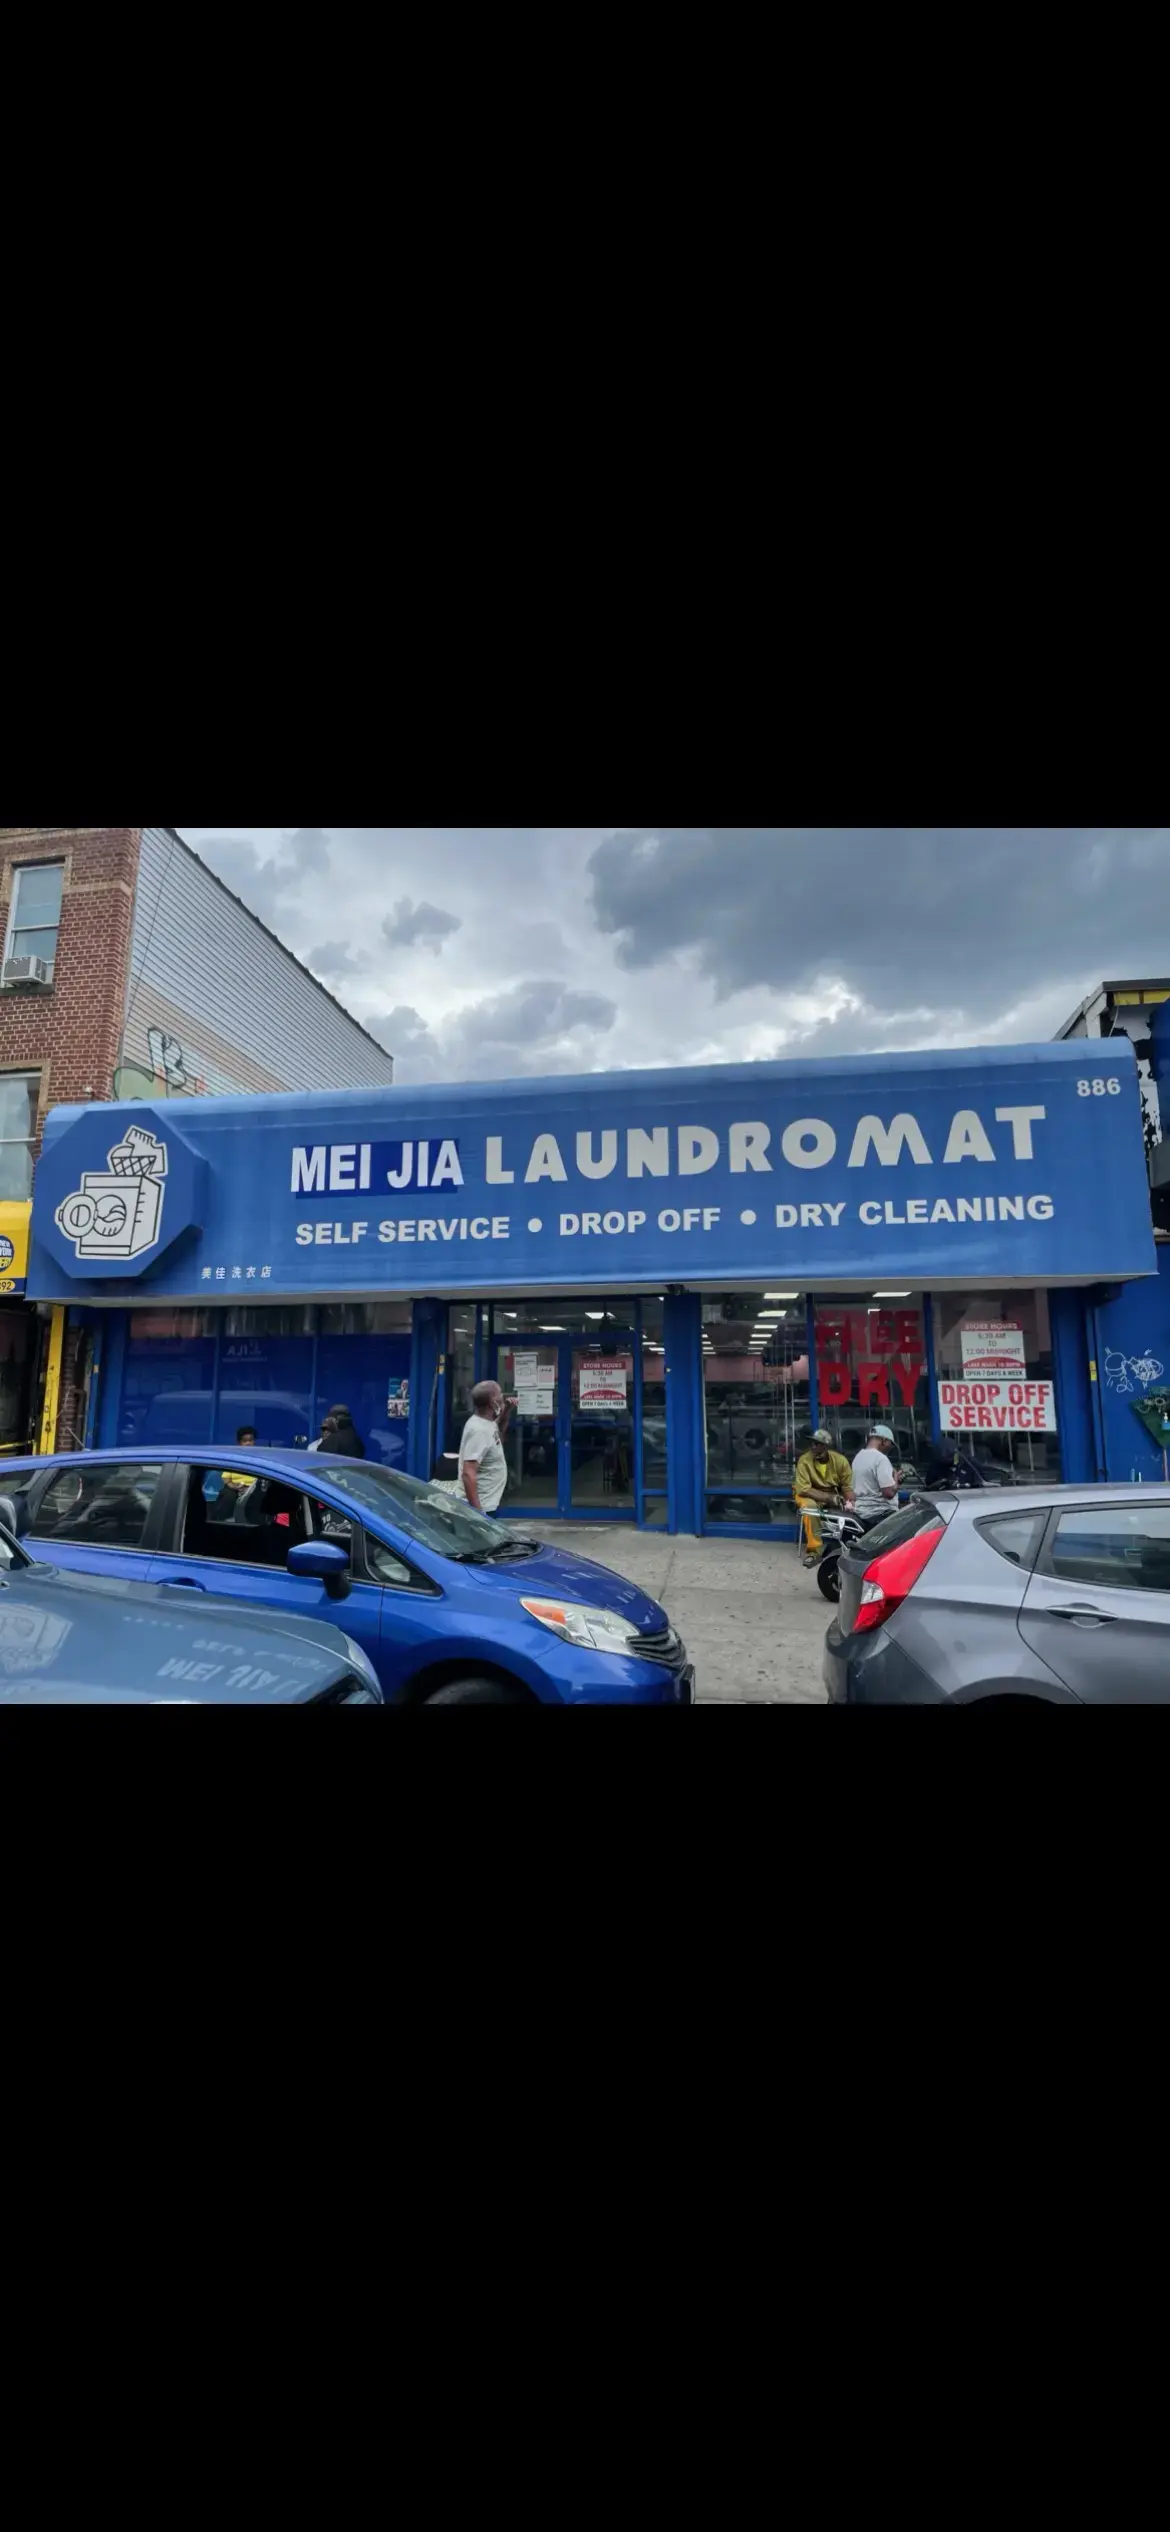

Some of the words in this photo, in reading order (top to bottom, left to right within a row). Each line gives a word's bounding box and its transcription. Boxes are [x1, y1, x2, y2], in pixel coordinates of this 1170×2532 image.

[1076, 1078, 1121, 1097] 886
[290, 1144, 371, 1192] MEI
[387, 1140, 464, 1188] JIA
[486, 1106, 1045, 1184] LAUNDROMAT
[295, 1221, 368, 1245] SELF
[378, 1217, 510, 1243] SERVICE
[559, 1210, 646, 1236] DROP
[658, 1207, 721, 1232] OFF
[776, 1202, 846, 1228] DRY
[858, 1195, 1054, 1226] CLEANING
[818, 1362, 921, 1407] DRY
[941, 1384, 1001, 1405] DROP
[1008, 1383, 1050, 1405] OFF
[949, 1406, 1047, 1428] SERVICE
